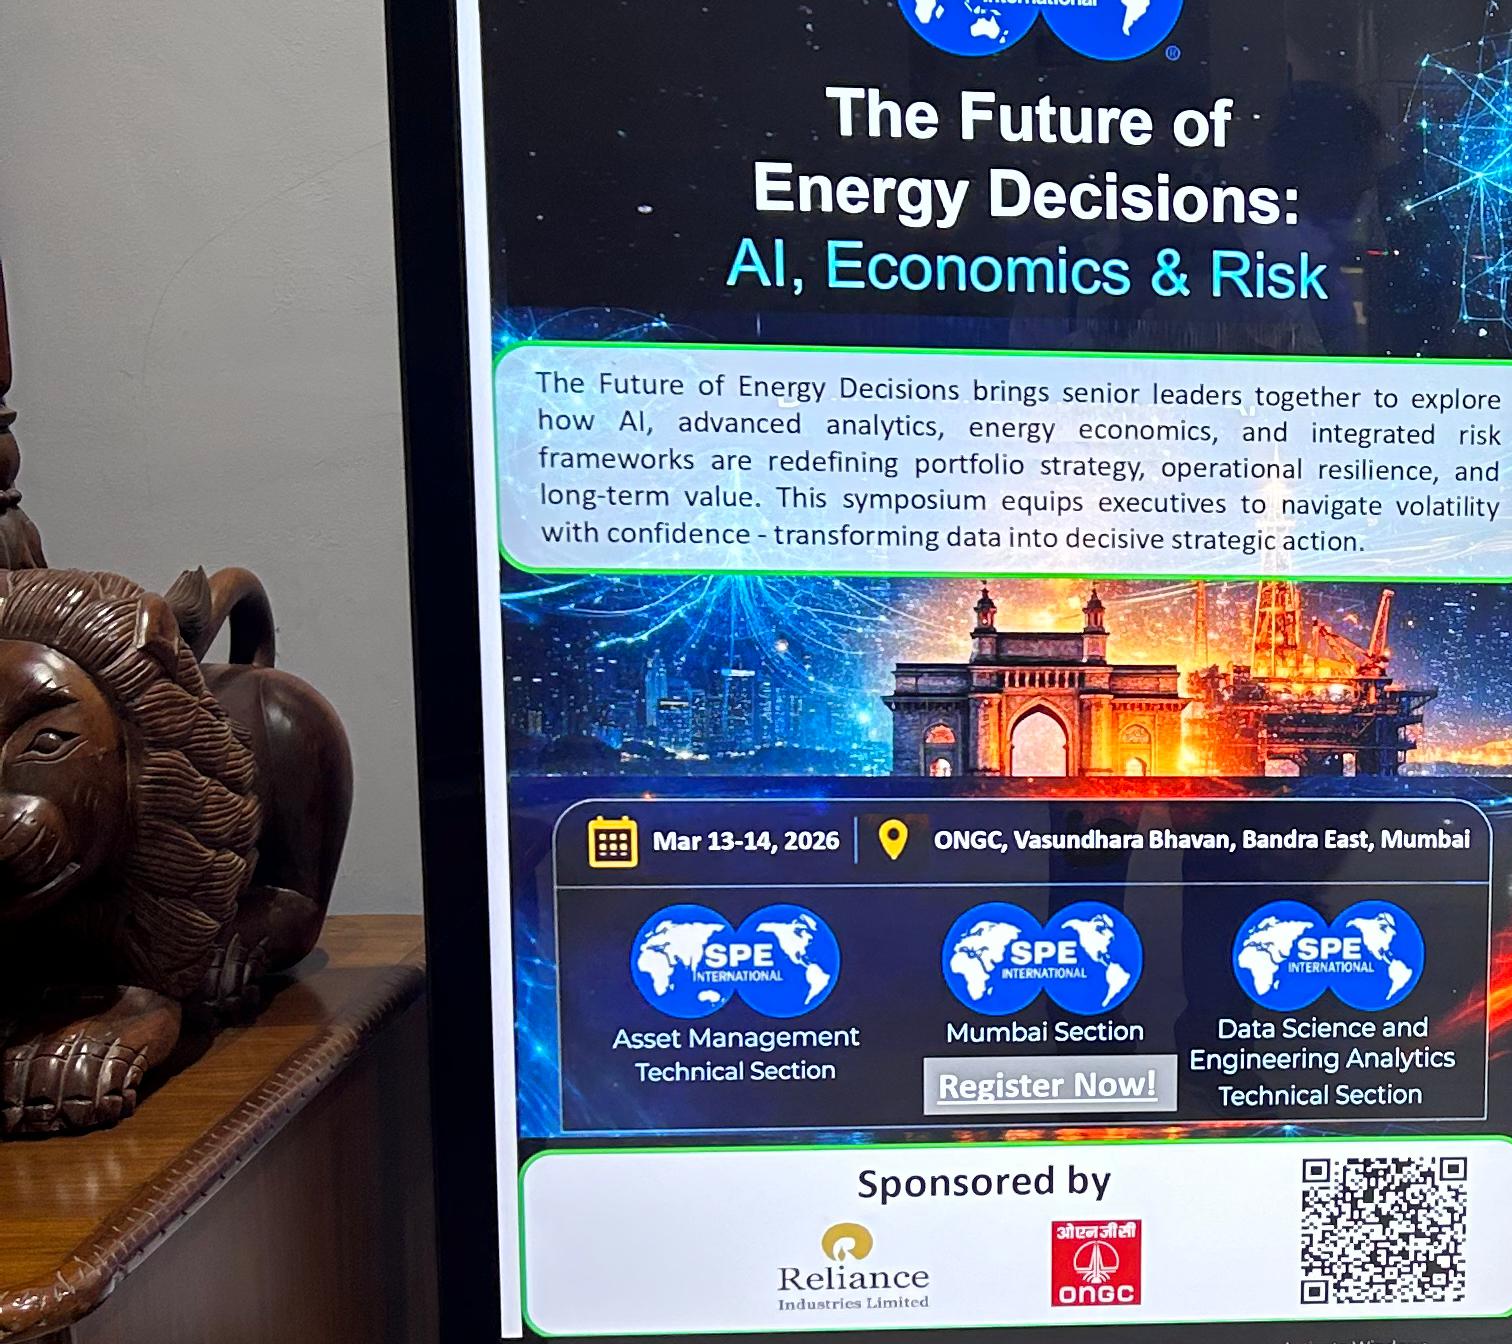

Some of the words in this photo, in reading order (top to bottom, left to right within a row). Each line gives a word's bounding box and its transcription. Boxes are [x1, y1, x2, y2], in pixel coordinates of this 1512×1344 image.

[825, 86, 939, 140] The
[961, 90, 1153, 146] Future
[1173, 98, 1234, 148] of
[754, 161, 970, 229] Energy
[990, 168, 1298, 225] Decisions:
[726, 237, 803, 296] AI,
[827, 239, 1131, 296] Economics
[1151, 247, 1191, 297] &
[1212, 249, 1329, 300] Risk
[535, 370, 585, 394] The
[600, 372, 684, 396] Future
[698, 373, 726, 396] of
[739, 375, 826, 403] Energy
[840, 377, 960, 401] Decisions
[973, 379, 1050, 407] brings
[1062, 382, 1140, 404] senior
[1153, 382, 1242, 406] leaders
[1254, 385, 1362, 412] together
[1373, 389, 1398, 409] to
[1411, 387, 1501, 415] explore
[538, 407, 595, 431] how
[619, 410, 653, 436] AI,
[678, 410, 801, 434] advanced
[827, 413, 944, 441] analytics,
[969, 421, 1056, 444] energy
[1079, 419, 1218, 446] economics,
[1242, 420, 1287, 443] and
[1312, 422, 1435, 449] integrated
[1459, 424, 1502, 446] risk
[538, 445, 694, 470] frameworks
[711, 454, 752, 471] are
[769, 449, 899, 478] redefining
[915, 452, 1025, 479] portfolio
[1040, 456, 1145, 482] strategy,
[1161, 457, 1302, 483] operational
[1319, 458, 1439, 486] resilience,
[1455, 460, 1499, 482] and
[541, 482, 669, 511] long-term
[684, 484, 761, 508] value.
[775, 485, 827, 509] This
[843, 488, 986, 514] symposium
[1001, 490, 1083, 517] equips
[1098, 492, 1227, 514] executives
[1240, 495, 1266, 514] to
[1282, 494, 1382, 520] navigate
[1396, 494, 1500, 522] volatility
[541, 520, 599, 543] with
[607, 521, 750, 545] confidence
[773, 523, 940, 552] transforming
[946, 525, 1001, 547] data
[1009, 526, 1058, 548] into
[1066, 526, 1164, 549] decisive
[1171, 529, 1276, 556] strategic
[1282, 530, 1365, 552] action.
[653, 831, 703, 851] Mar
[707, 831, 779, 855] 13-14,
[784, 830, 840, 851] 2026
[934, 830, 1008, 854] ONGC,
[1013, 828, 1144, 850] Vasundhara
[1149, 828, 1237, 853] Bhavan,
[1242, 828, 1319, 849] Bandra
[1324, 829, 1375, 853] East,
[1381, 828, 1471, 849] Mumbai
[706, 943, 774, 967] SPE
[1011, 940, 1077, 965] SPE
[1298, 937, 1362, 960] SPE
[692, 969, 783, 982] INTERNATIONAL
[1001, 967, 1087, 980] INTERNATIONAL
[1288, 961, 1374, 974] INTERNATIONAL
[612, 1028, 682, 1050] Asset
[689, 1027, 861, 1053] Management
[947, 1020, 1048, 1043] Mumbai
[1054, 1020, 1144, 1042] Section
[1218, 1018, 1276, 1039] Data
[1282, 1016, 1377, 1039] Science
[1382, 1016, 1428, 1038] and
[634, 1060, 744, 1082] Technical
[750, 1059, 836, 1081] Section
[1190, 1047, 1339, 1075] Engineering
[1345, 1045, 1456, 1073] Analytics
[938, 1074, 1065, 1104] Register
[1073, 1069, 1158, 1098] Now!
[1218, 1084, 1329, 1107] Technical
[1335, 1083, 1423, 1106] Section
[858, 1164, 1054, 1206] Sponsored
[1068, 1164, 1112, 1202] by
[778, 1265, 929, 1291] Reliance
[778, 1299, 861, 1310] Industries
[867, 1297, 929, 1309] Limited
[1058, 1285, 1134, 1303] ONGC
